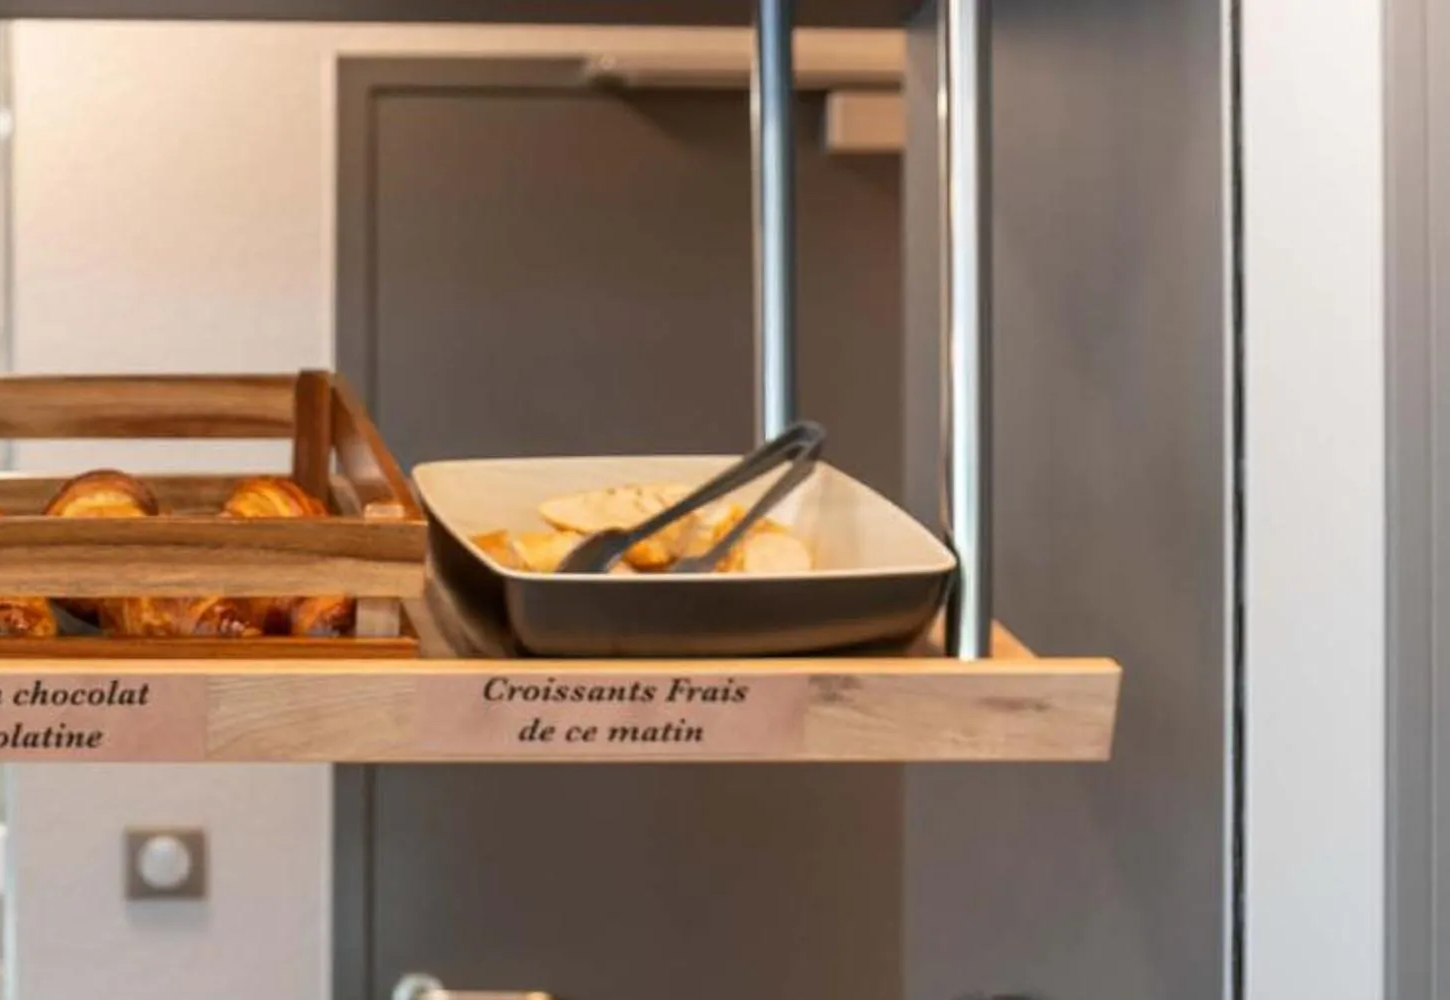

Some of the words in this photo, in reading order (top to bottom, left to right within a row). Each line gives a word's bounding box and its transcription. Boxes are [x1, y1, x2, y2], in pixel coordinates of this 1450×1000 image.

[12, 679, 150, 706] chocolat
[482, 676, 658, 703] Croissants
[665, 676, 749, 703] Frais
[517, 718, 555, 743] de
[564, 724, 598, 743] ce
[607, 718, 704, 743] matin
